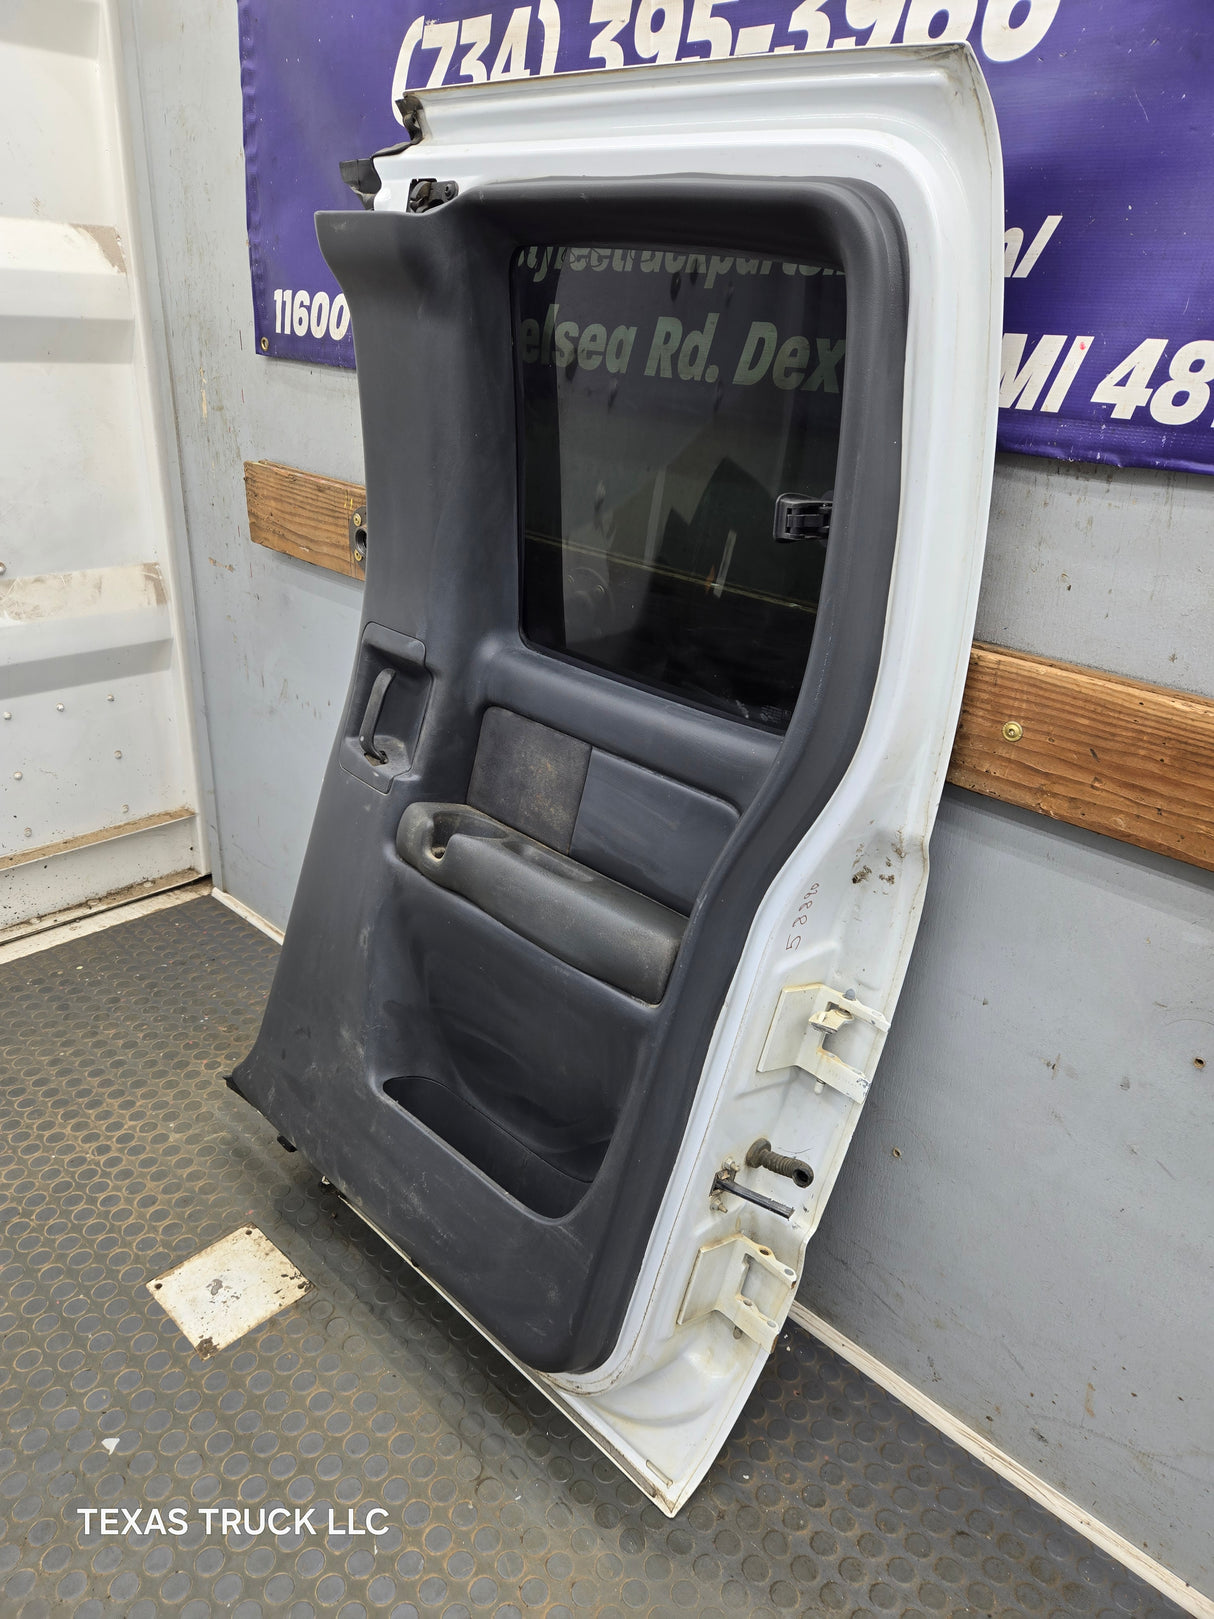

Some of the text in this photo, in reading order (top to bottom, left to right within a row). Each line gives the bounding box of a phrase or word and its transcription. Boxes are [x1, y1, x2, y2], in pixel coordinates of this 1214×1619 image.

[391, 0, 561, 127] (734)
[273, 288, 351, 341] 11600
[644, 313, 720, 383] Rd.
[732, 321, 846, 394] Dex
[998, 333, 1095, 413] MI
[1090, 338, 1214, 427] 48
